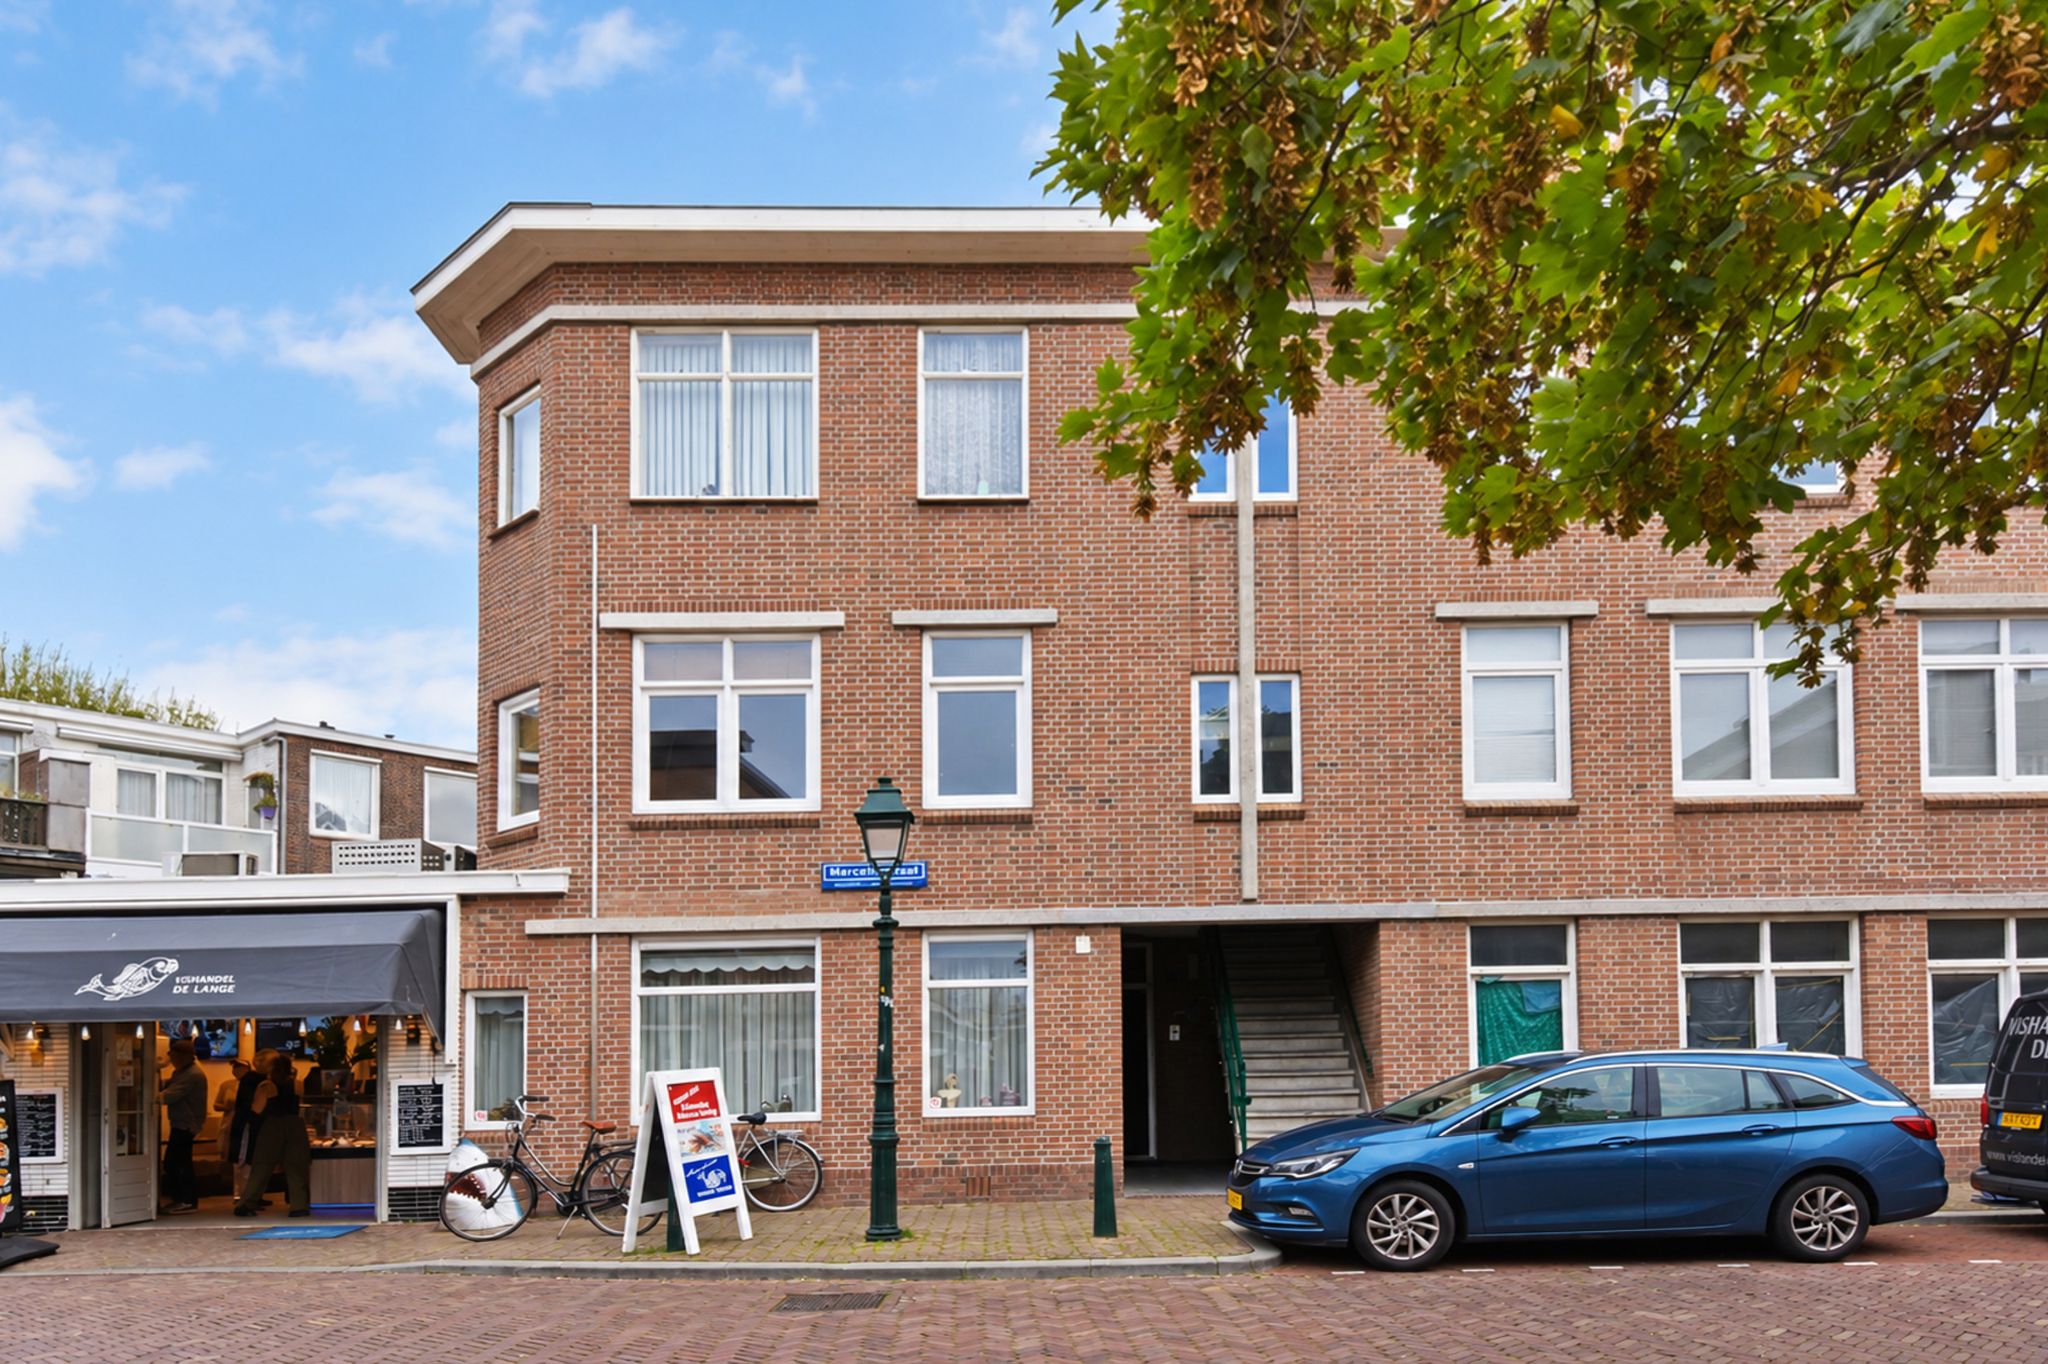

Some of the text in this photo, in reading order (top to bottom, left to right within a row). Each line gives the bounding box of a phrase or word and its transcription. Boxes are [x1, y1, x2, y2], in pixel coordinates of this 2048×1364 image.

[829, 866, 919, 876] Marceliraat
[172, 984, 235, 994] DE LANGE
